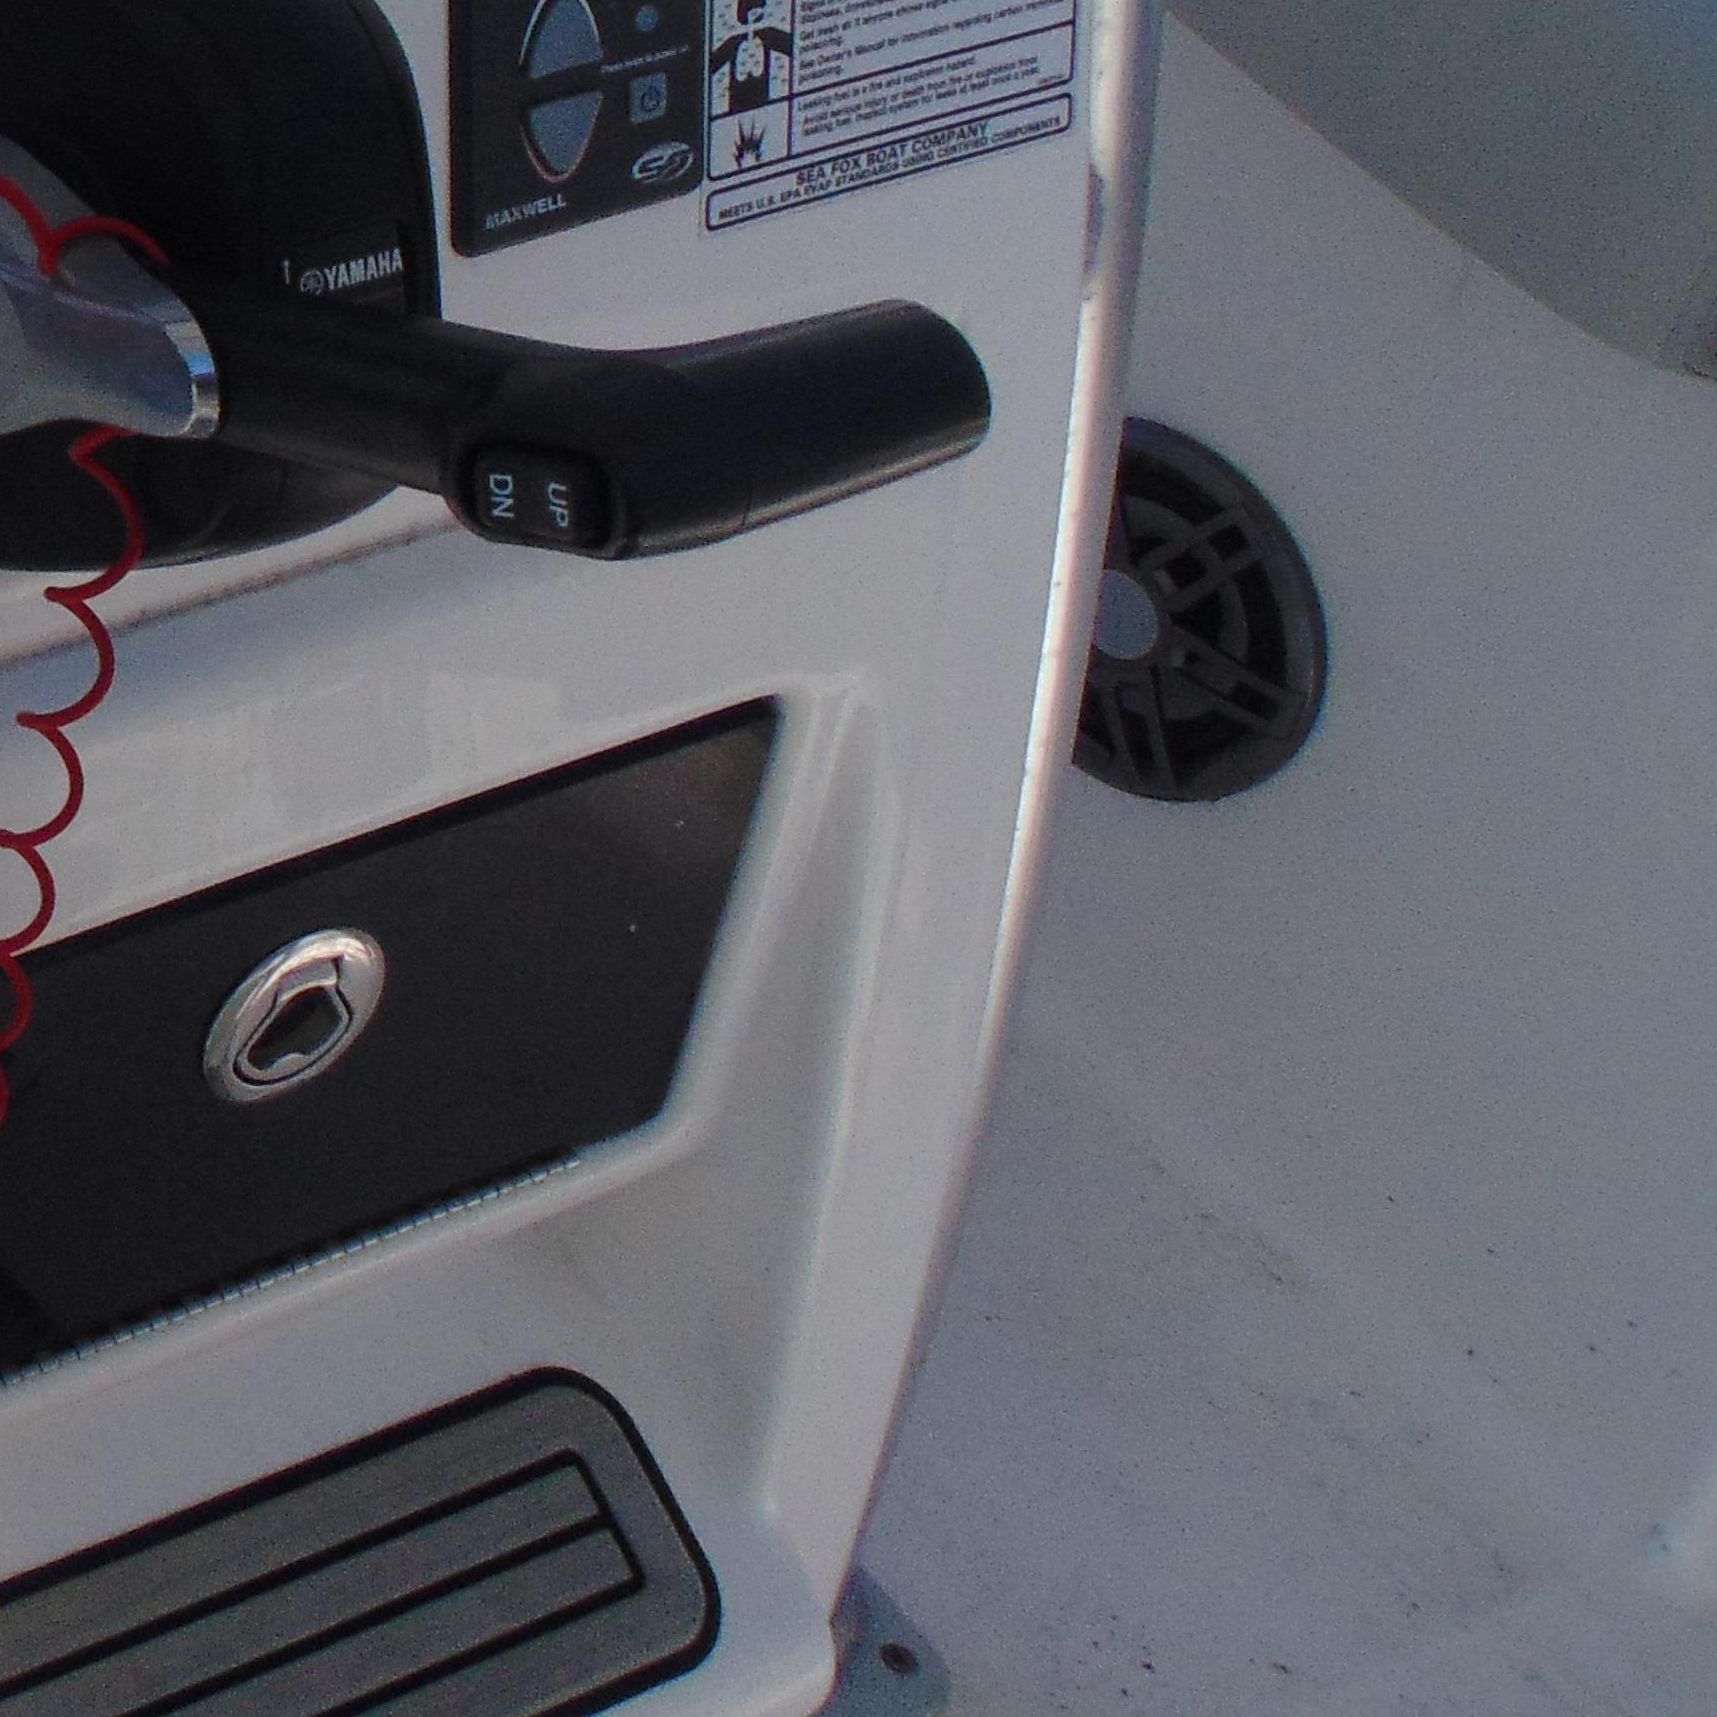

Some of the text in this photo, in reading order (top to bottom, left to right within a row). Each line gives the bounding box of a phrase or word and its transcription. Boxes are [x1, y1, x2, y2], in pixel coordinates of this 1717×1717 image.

[796, 120, 988, 186] SEA FOX BOAT COMPANY
[483, 193, 566, 231] MAXWELL
[325, 248, 403, 290] YAMAHA
[489, 473, 514, 518] DN
[547, 481, 571, 527] UP
